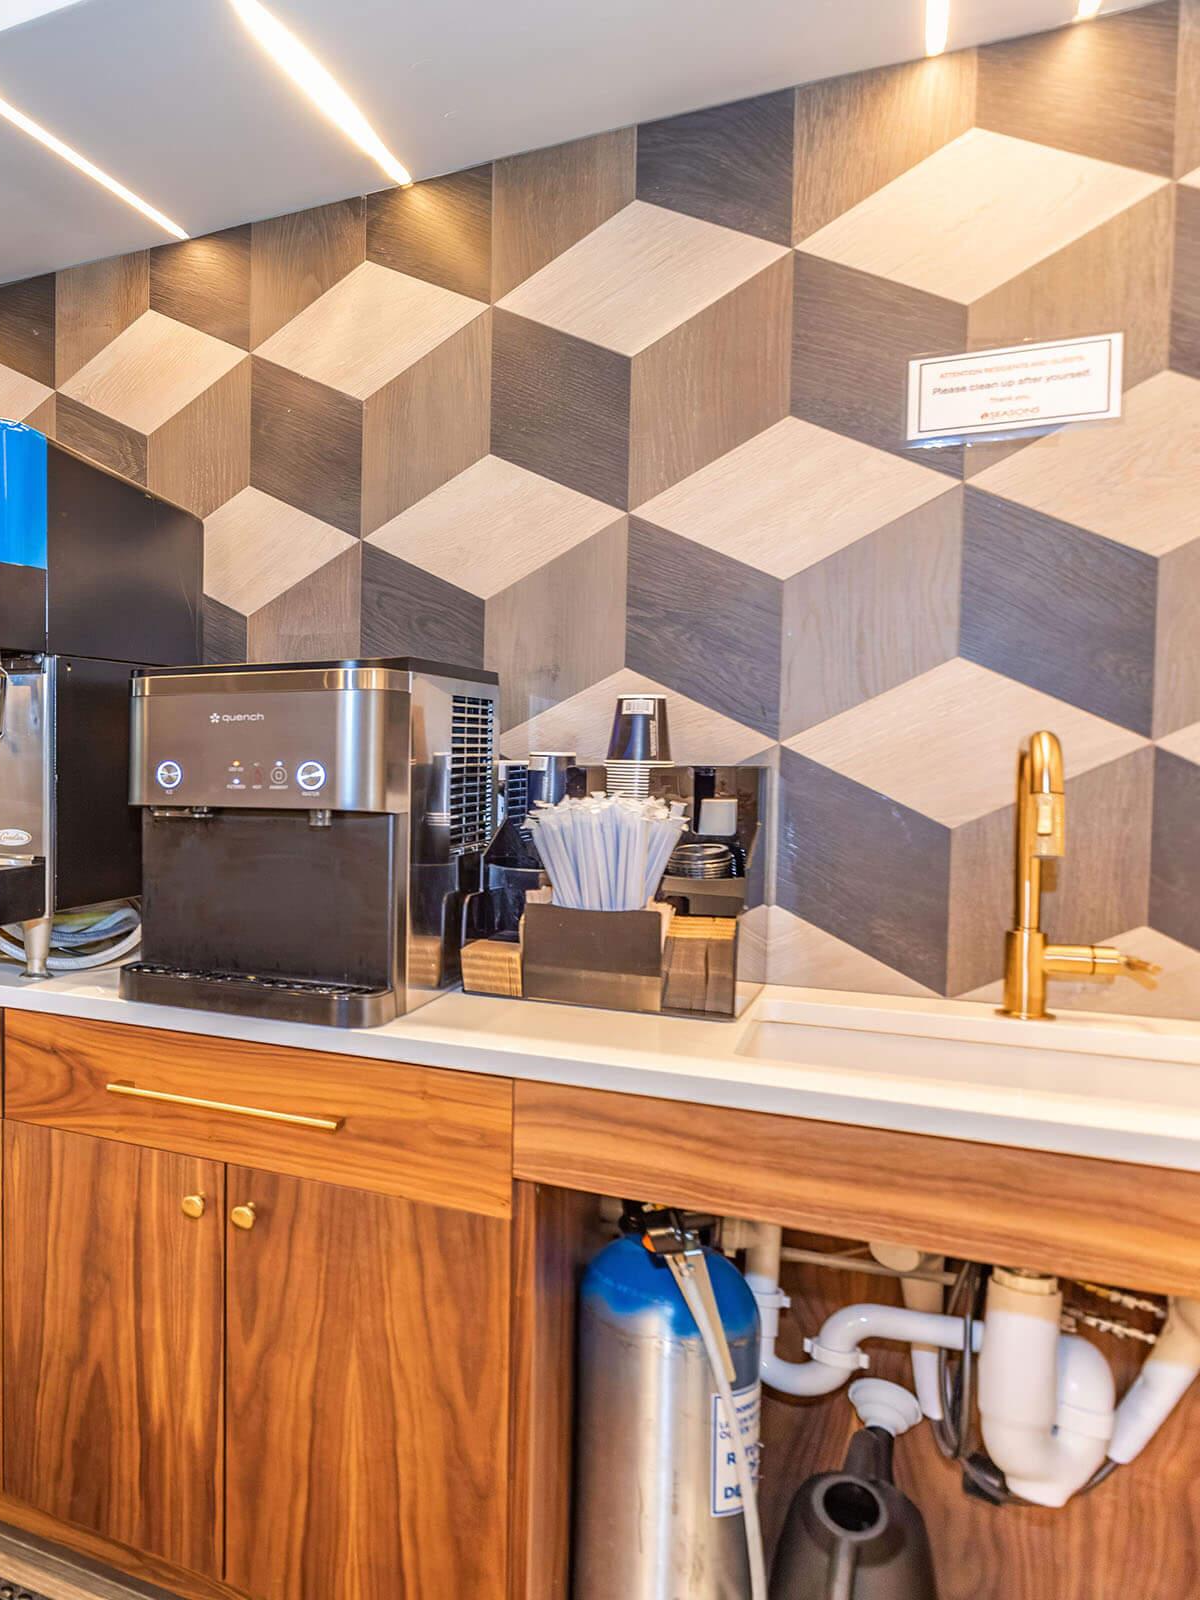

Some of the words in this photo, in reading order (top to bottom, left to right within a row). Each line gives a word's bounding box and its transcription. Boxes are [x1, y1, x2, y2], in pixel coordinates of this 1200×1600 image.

[932, 385, 967, 396] Please
[969, 381, 999, 391] clean
[1000, 379, 1016, 390] up
[1019, 376, 1042, 385] after
[222, 712, 265, 723] quench
